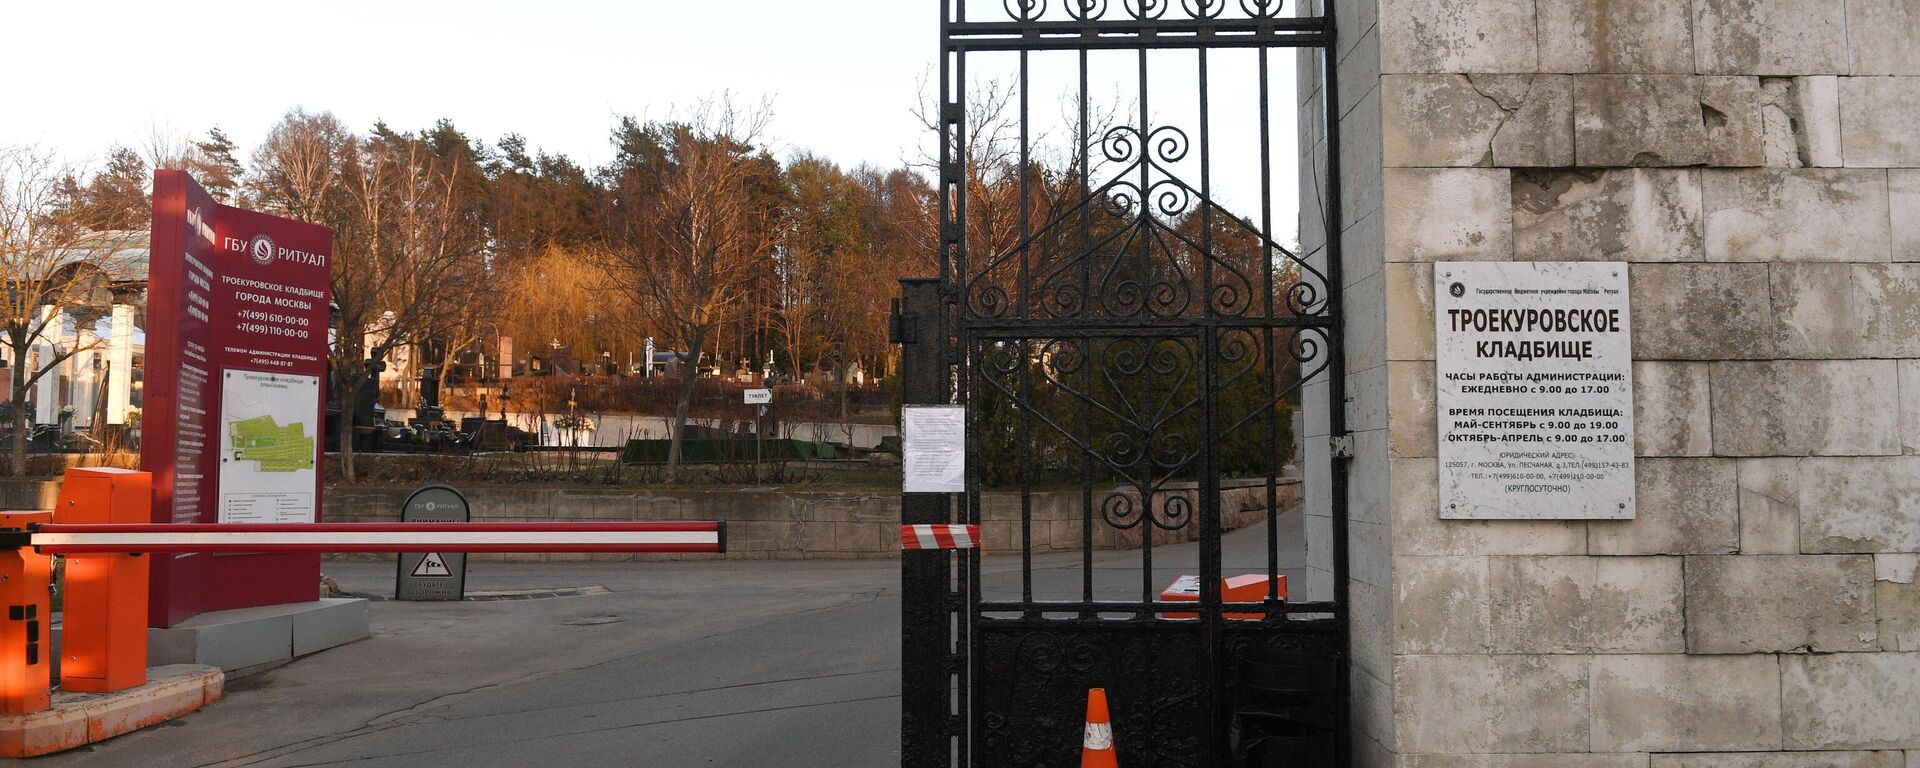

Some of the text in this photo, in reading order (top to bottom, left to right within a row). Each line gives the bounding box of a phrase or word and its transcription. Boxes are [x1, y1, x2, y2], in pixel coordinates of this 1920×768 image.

[224, 236, 325, 267] ГБУ РИТУАЛ
[222, 275, 282, 292] ТРОЕКУРОВСКОЕ
[284, 286, 324, 299] КЛАДБИЩЕ
[235, 291, 312, 310] ГОРОДА МОСКВЫ
[237, 310, 309, 326] +7(499) 610-00-00
[1448, 308, 1620, 332] ТРОЕКУРОВСКОЕ
[236, 322, 308, 338] +7(499) 110-00-00
[249, 349, 290, 358] АДМИНИСТРАЦИИ
[1476, 340, 1592, 361] КЛАДБИЩЕ
[1446, 373, 1625, 382] ЧАСЫ РАБОТЫ АДМИНИСТРАЦИИ:
[1461, 386, 1527, 394] ЕЖЕДНЕВНО
[1539, 386, 1562, 394] 9.00
[1488, 409, 1555, 418] ПОСЕЩЕНИЯ
[1558, 409, 1623, 418] КЛАДБИЩА:
[1454, 420, 1536, 429] МАЙ-СЕНТЯБРЬ
[1448, 434, 1544, 442] ОКТЯБРЬ-АПРЕЛЬ
[1597, 434, 1625, 442] 17.00
[1500, 451, 1550, 459] ЮРИДИЧЕСКИЙ
[1505, 484, 1570, 494] (КРУГЛОСУТОЧНО)
